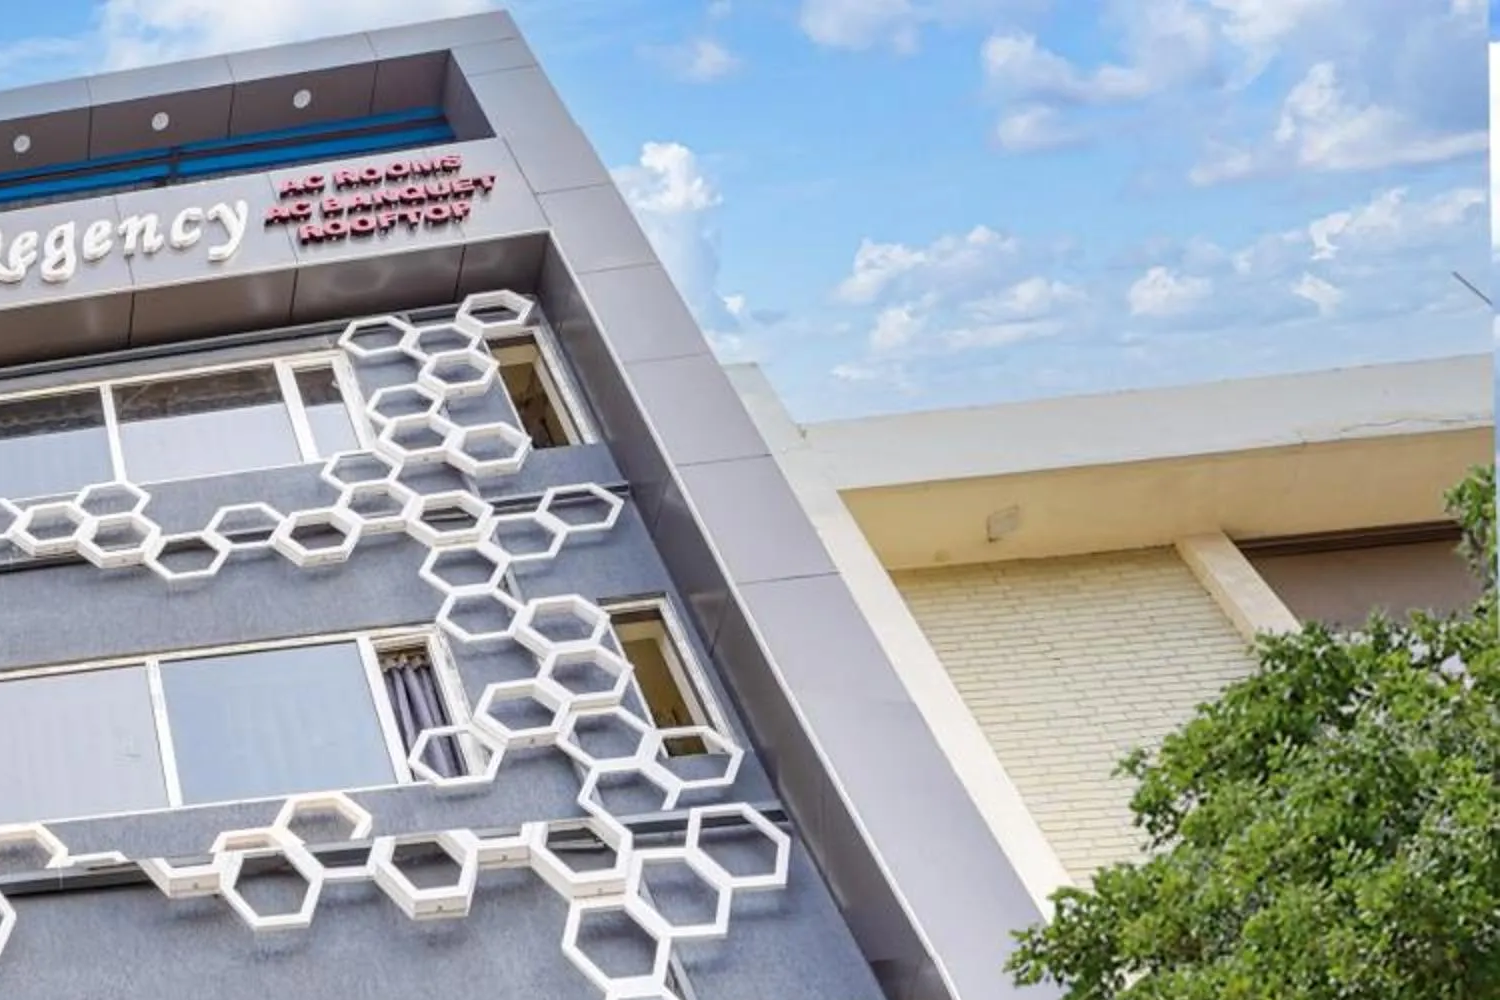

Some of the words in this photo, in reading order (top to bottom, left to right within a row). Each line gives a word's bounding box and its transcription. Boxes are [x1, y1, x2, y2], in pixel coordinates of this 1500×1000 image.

[280, 175, 324, 199] AC
[332, 155, 463, 191] ROOMS
[265, 202, 312, 227] AC
[320, 175, 496, 219] BANQUET
[298, 201, 471, 245] ROOFTOP
